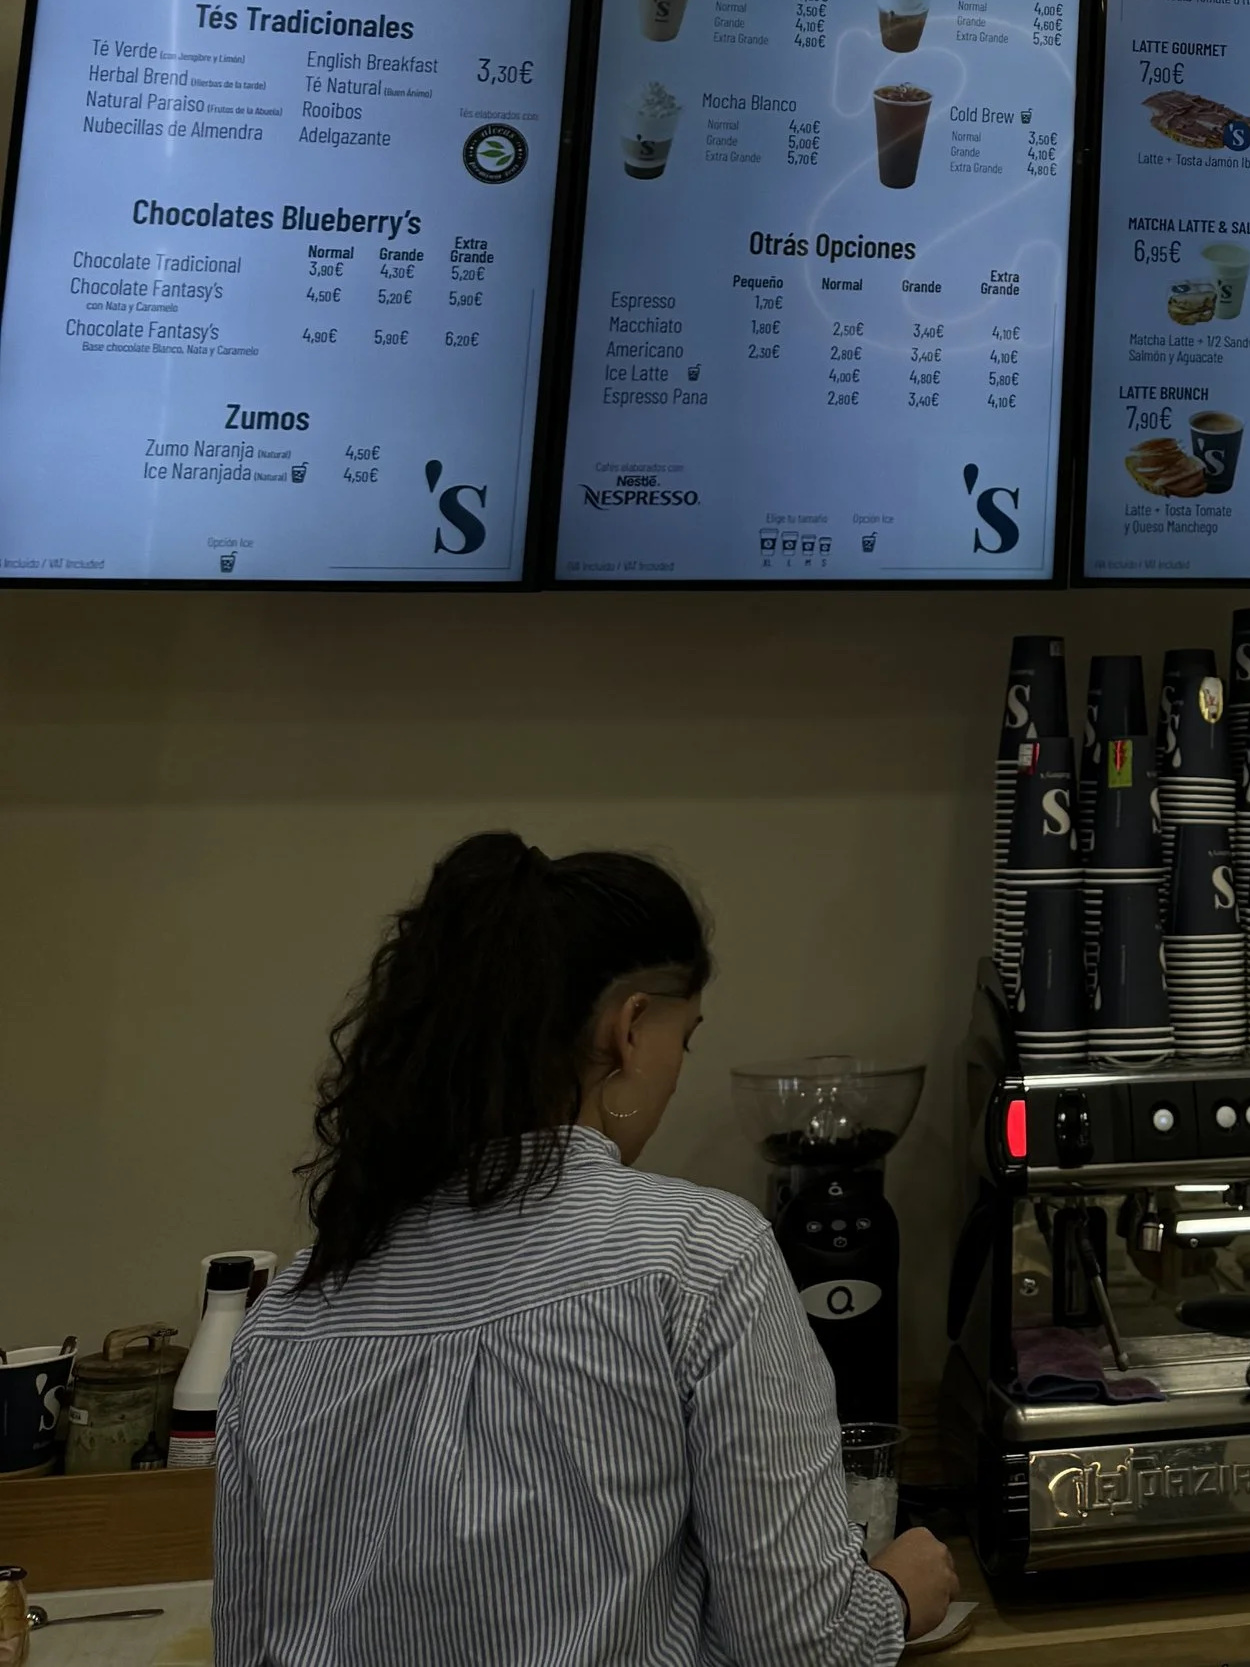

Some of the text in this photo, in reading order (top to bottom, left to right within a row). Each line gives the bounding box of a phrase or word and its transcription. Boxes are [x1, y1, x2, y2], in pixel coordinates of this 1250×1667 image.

[196, 3, 414, 40] Tés Tradicionales
[92, 39, 158, 59] Té Verde
[1132, 39, 1227, 57] LATTE GOURMET
[89, 64, 188, 86] Herbal Brend
[307, 51, 534, 85] English Breakfast 3,30€
[1140, 60, 1185, 85] 7,90€
[305, 75, 382, 95] Té Natural
[86, 90, 143, 109] Natural
[302, 101, 362, 120] Rooibos
[702, 93, 797, 112] Mocha Blanco
[950, 106, 1015, 124] Cold Brew
[83, 116, 263, 141] Nubecillas de Almendra
[298, 126, 391, 148] Adelgazante
[133, 199, 421, 241] Chocolates Blueberry's
[1128, 217, 1175, 232] MATCHA
[1178, 219, 1216, 233] LATTE
[1218, 220, 1228, 234] &
[750, 231, 916, 263] Otrás Opciones
[1134, 239, 1181, 265] 6,95€
[73, 251, 486, 281] Chocolate Tradicional 3,90€ 4,30€ 5,20€
[990, 270, 1019, 283] Extra
[733, 274, 1020, 296] Pequeño Normal Grande Grande
[611, 291, 783, 312] Espresso 1,70€
[609, 316, 1021, 341] Macchiato 1,80€ 2,50€ 3,40€ 4,10€
[606, 341, 780, 359] Americano 2,30€
[605, 364, 669, 382] Ice Latte
[603, 387, 708, 408] Espresso Pana
[1119, 386, 1209, 401] LATTE BRUNCH
[224, 404, 310, 431] Zumos
[1126, 405, 1172, 432] 7,90€
[145, 438, 381, 462] Zumo Naranja 4,50€
[144, 462, 379, 485] Ice Naranjada 4,50€
